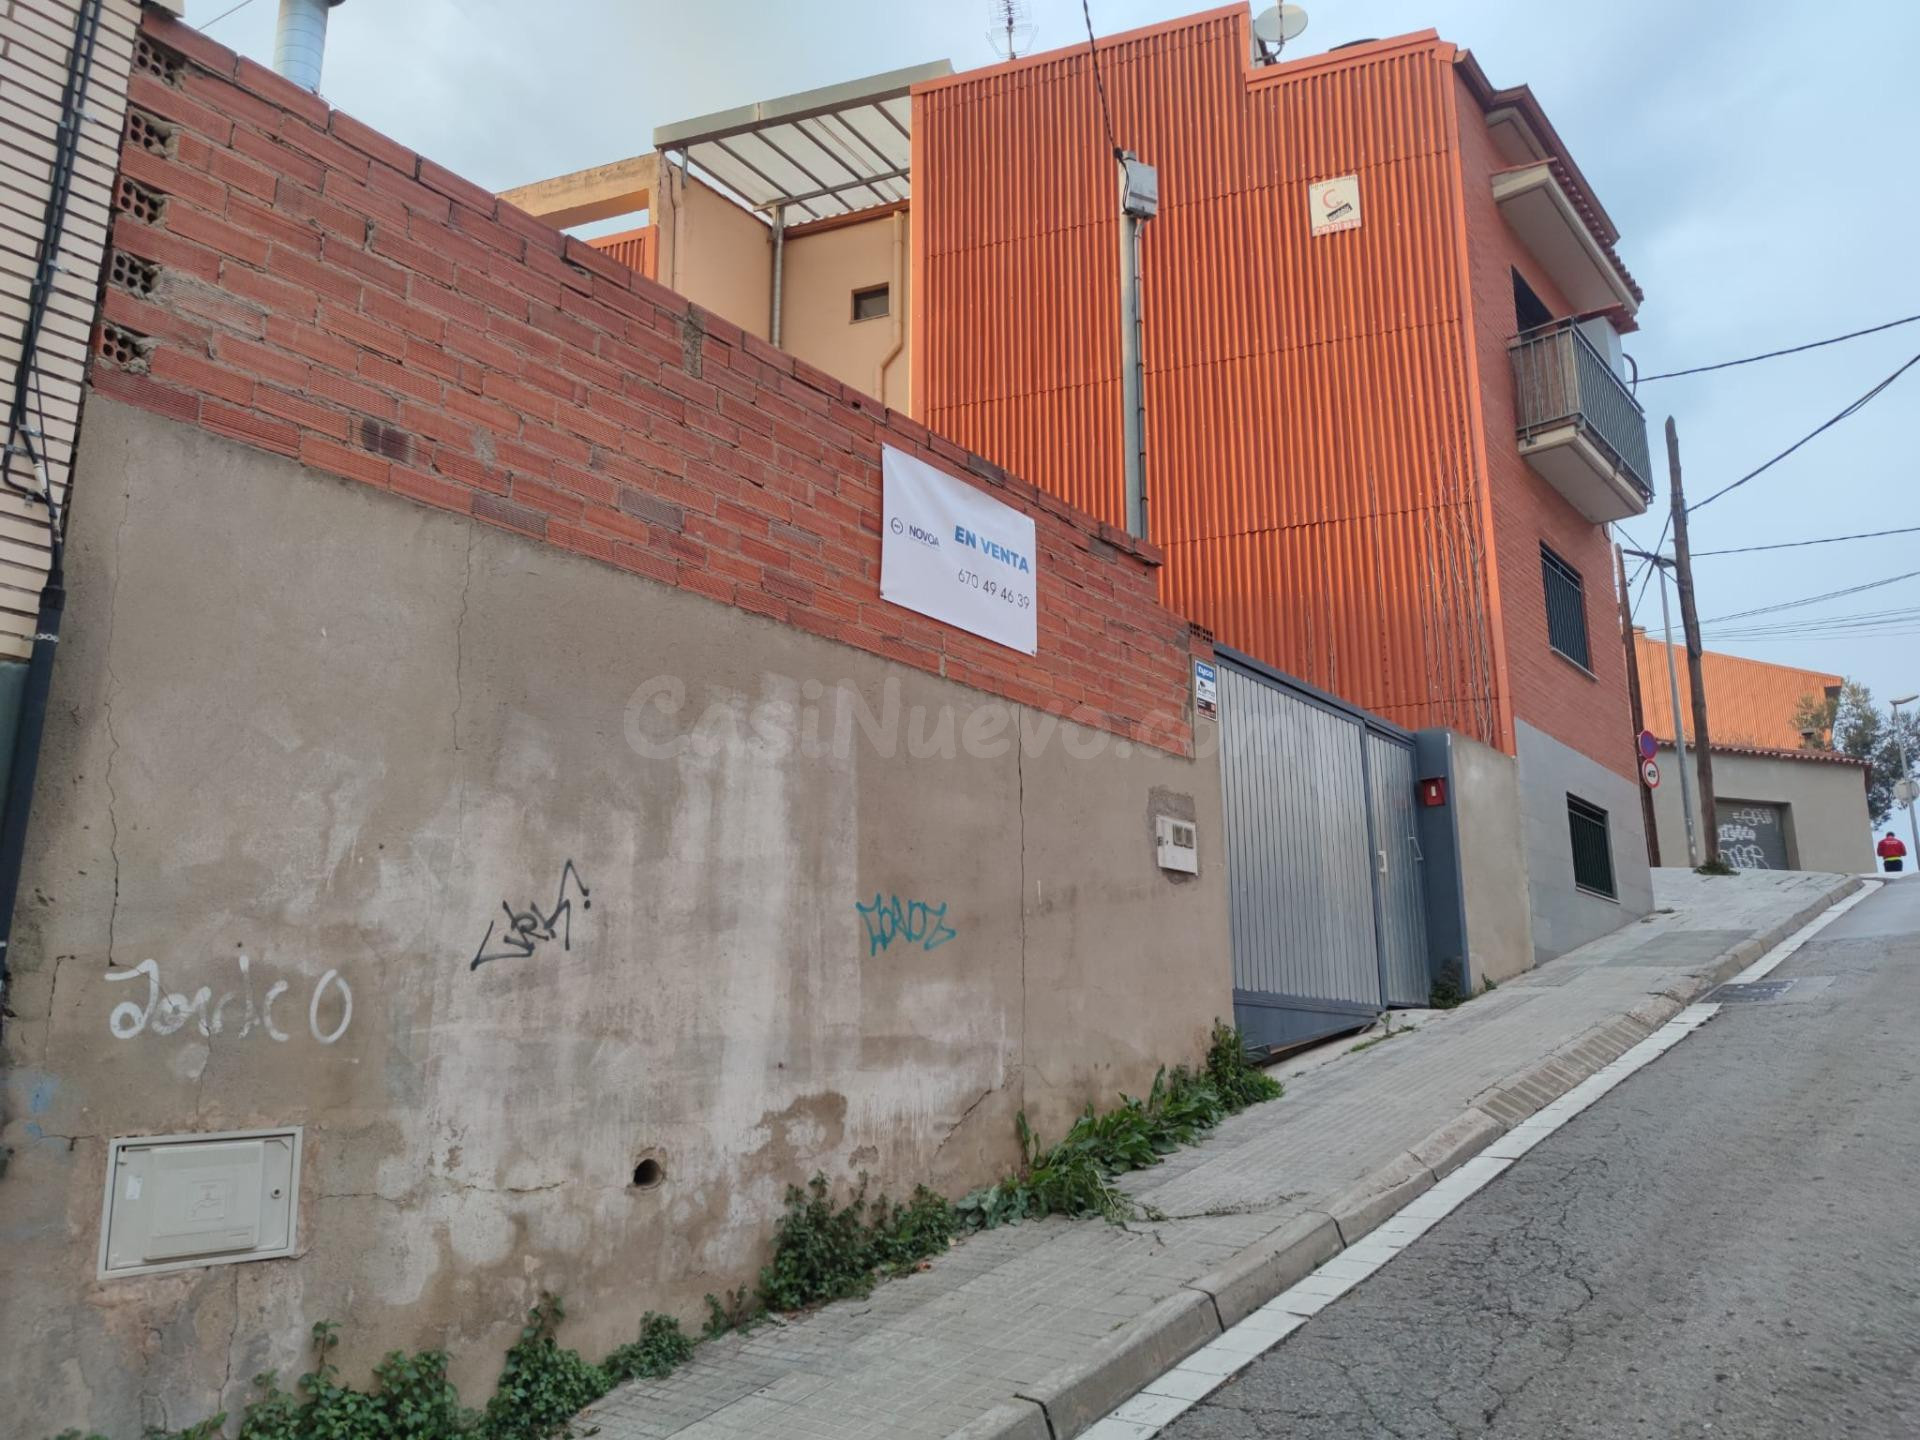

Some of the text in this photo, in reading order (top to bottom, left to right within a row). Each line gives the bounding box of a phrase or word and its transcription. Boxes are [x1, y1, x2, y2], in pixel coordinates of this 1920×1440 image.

[954, 524, 977, 549] EN
[980, 536, 1030, 574] VENTA
[958, 568, 1031, 610] 670 49 46 39
